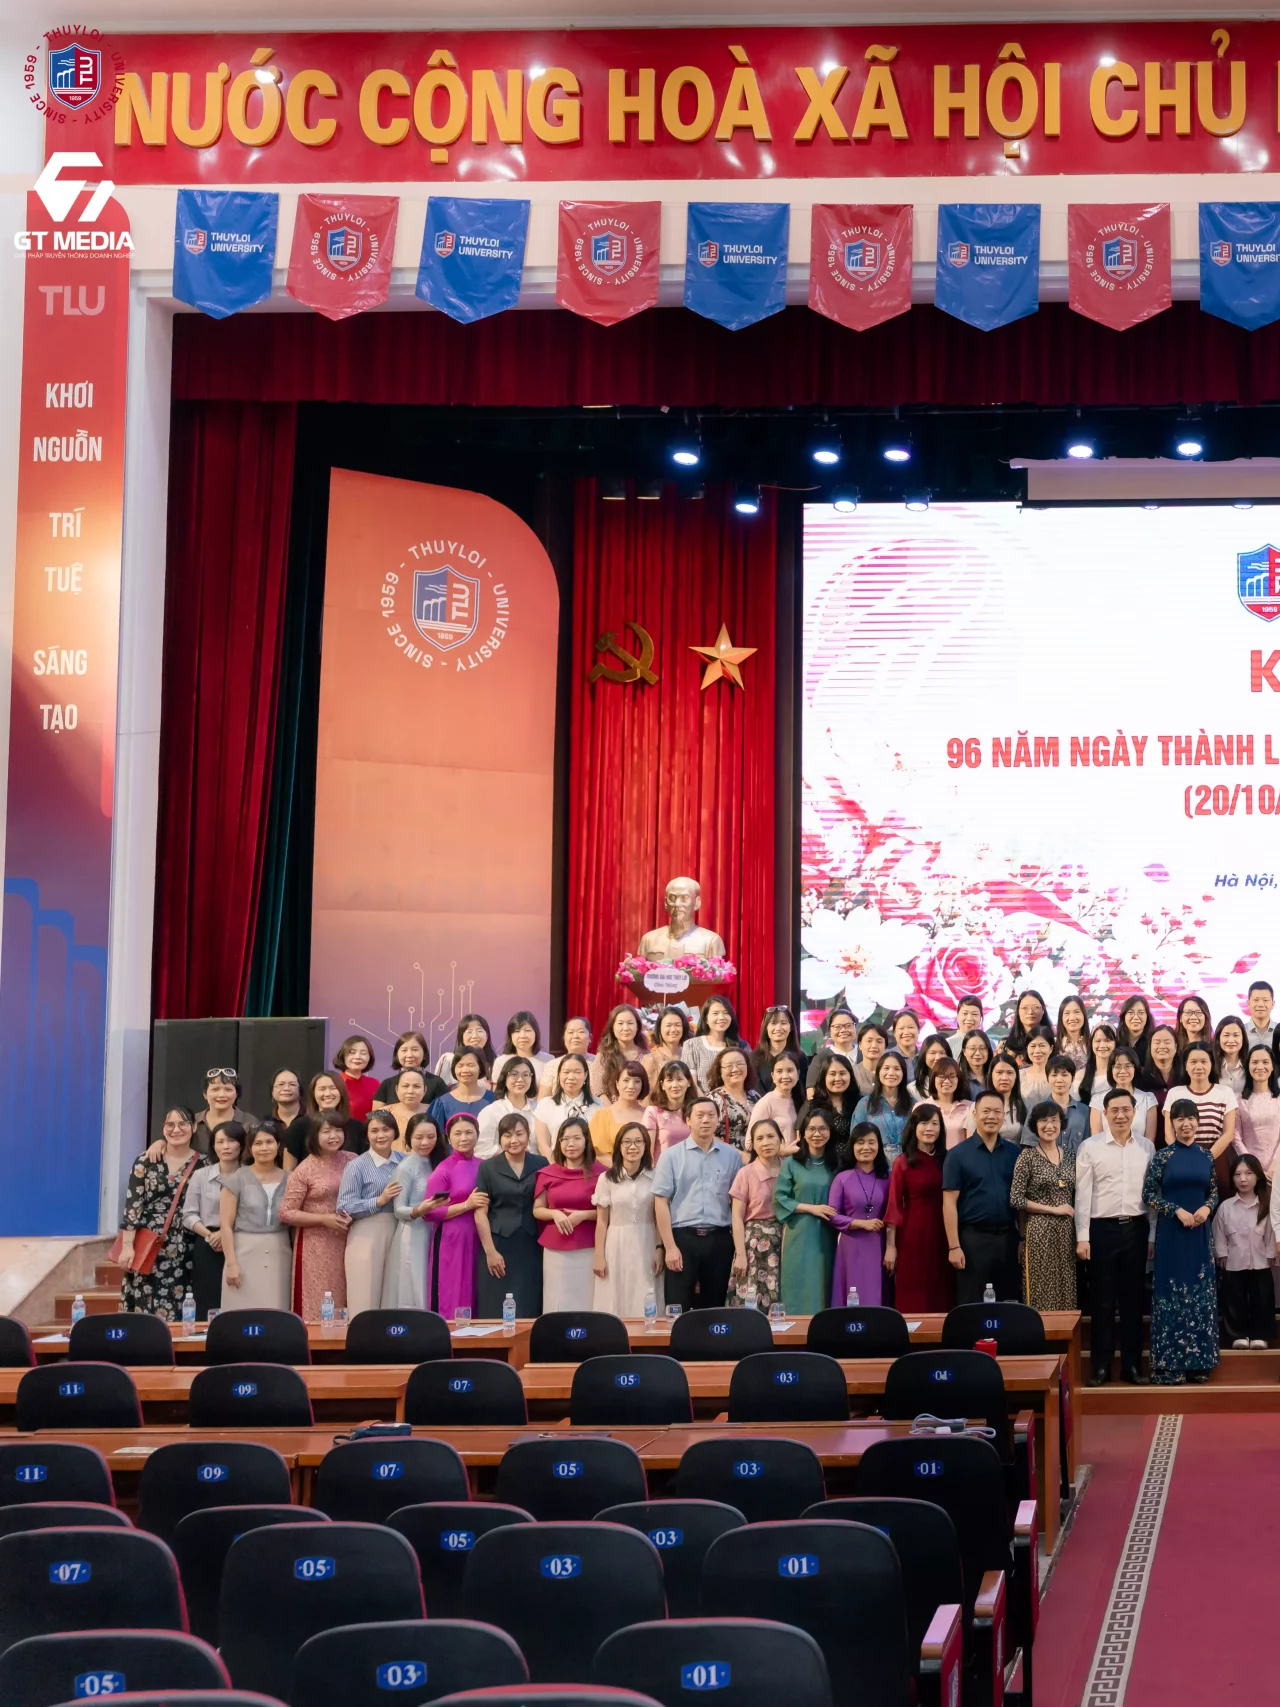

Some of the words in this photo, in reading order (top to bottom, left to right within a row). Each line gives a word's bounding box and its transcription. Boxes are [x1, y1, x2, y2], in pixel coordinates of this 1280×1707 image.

[114, 47, 336, 147] NƯỚC
[358, 50, 580, 163] CỘNG
[608, 46, 770, 142] HOÀ
[793, 45, 908, 140] XÃ
[933, 43, 1061, 158] HỘI
[1089, 29, 1246, 136] CHỦ
[587, 218, 630, 231] THUYLOI
[211, 232, 251, 243] THUYLOI
[460, 236, 500, 248] THUYLOI
[211, 244, 264, 254] UNIVERSITY
[459, 247, 514, 260] UNIVERSITY
[574, 237, 585, 263] 1959
[723, 244, 763, 254] THUYLOI
[974, 245, 1014, 255] THUYLOI
[1236, 244, 1276, 253] THUYLOI
[614, 236, 645, 286] UNIVERSITY
[723, 255, 778, 265] UNIVERSITY
[974, 256, 1028, 266] UNIVERSITY
[578, 263, 603, 286] SINCE
[39, 286, 105, 315] TLU
[45, 382, 94, 409] KHƠI
[33, 429, 102, 463] NGUỒN
[49, 507, 86, 538] TRÍ
[407, 539, 487, 569] THUYLOI
[45, 563, 84, 596] TUỆ
[380, 571, 399, 618] 1959
[456, 583, 509, 672] UNIVERSITY
[387, 624, 433, 669] SINCE
[33, 645, 88, 677] SÁNG
[40, 704, 78, 735] TẠO
[946, 738, 982, 768] 96
[992, 730, 1060, 768] NĂM
[1069, 729, 1149, 767] NGÀY
[1157, 728, 1255, 767] THÀNH
[1214, 873, 1239, 887] Hà
[1245, 871, 1279, 891] Nội,
[24, 1467, 39, 1480] 11
[203, 1467, 222, 1479] 09
[379, 1463, 397, 1477] 07
[558, 1463, 577, 1476] 05
[739, 1462, 757, 1475] 03
[920, 1462, 936, 1475] 01
[448, 1533, 467, 1548] 05
[656, 1531, 677, 1546] 03
[58, 1563, 81, 1581] 07
[302, 1559, 326, 1577] 05
[550, 1558, 573, 1575] 03
[787, 1557, 808, 1575] 01
[387, 1664, 417, 1686] 03
[693, 1665, 718, 1686] 01
[84, 1674, 114, 1697] 05
